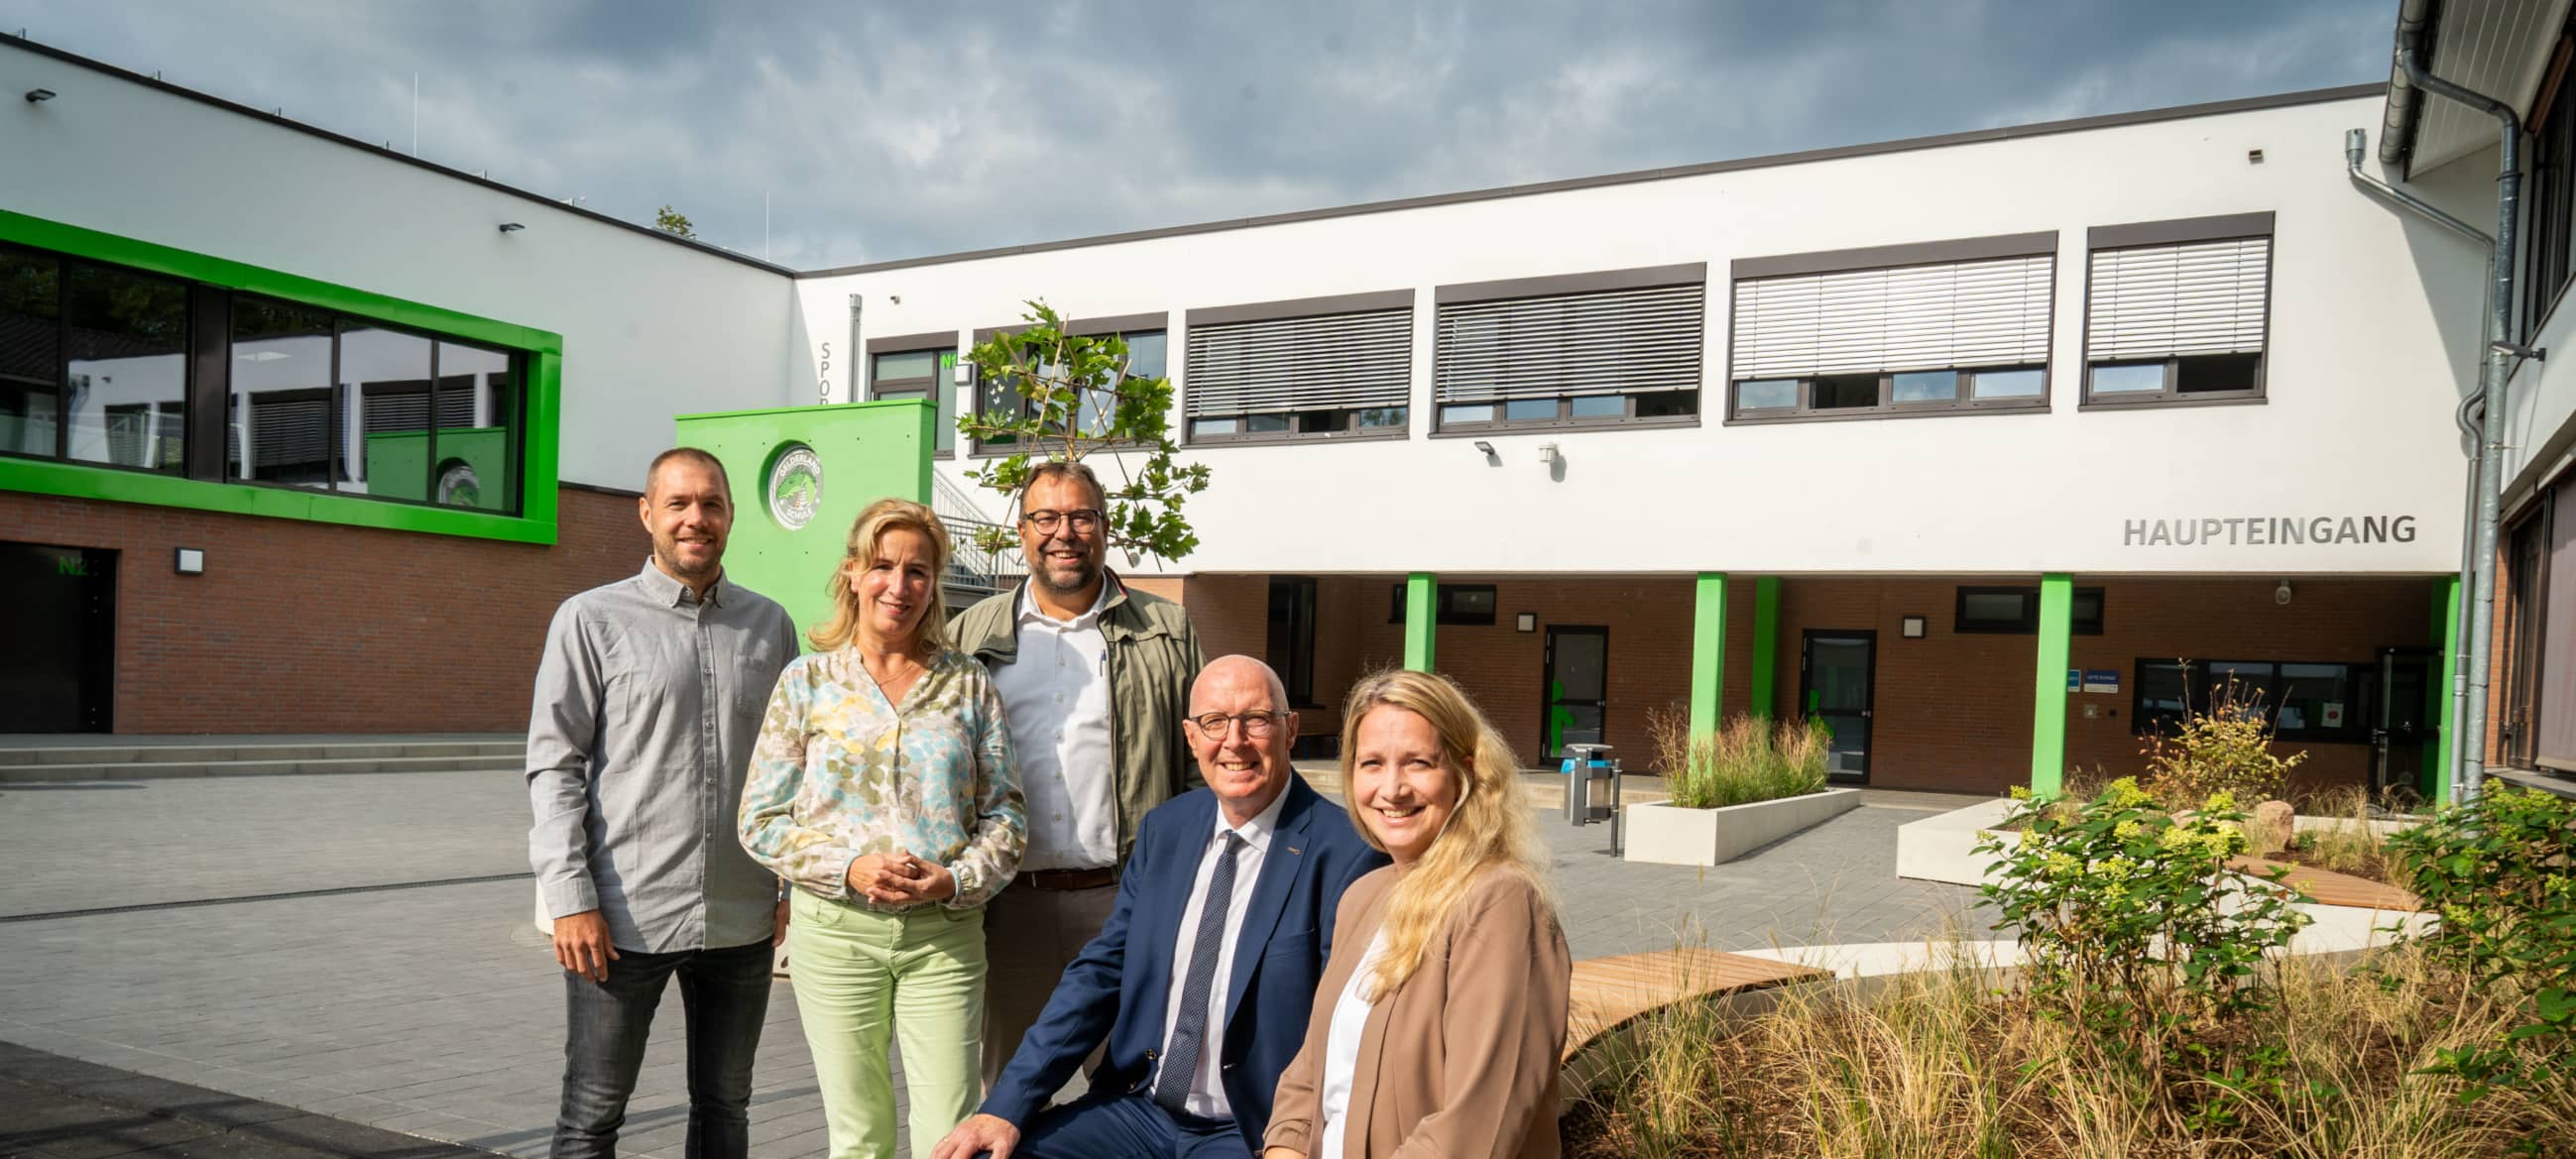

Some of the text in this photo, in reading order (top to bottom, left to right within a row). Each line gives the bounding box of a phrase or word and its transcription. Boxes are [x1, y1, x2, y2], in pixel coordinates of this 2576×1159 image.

[941, 353, 957, 369] N1
[778, 454, 821, 477] GELDERLAND
[2124, 515, 2416, 546] HAUPTEINGANG
[59, 555, 88, 576] N2
